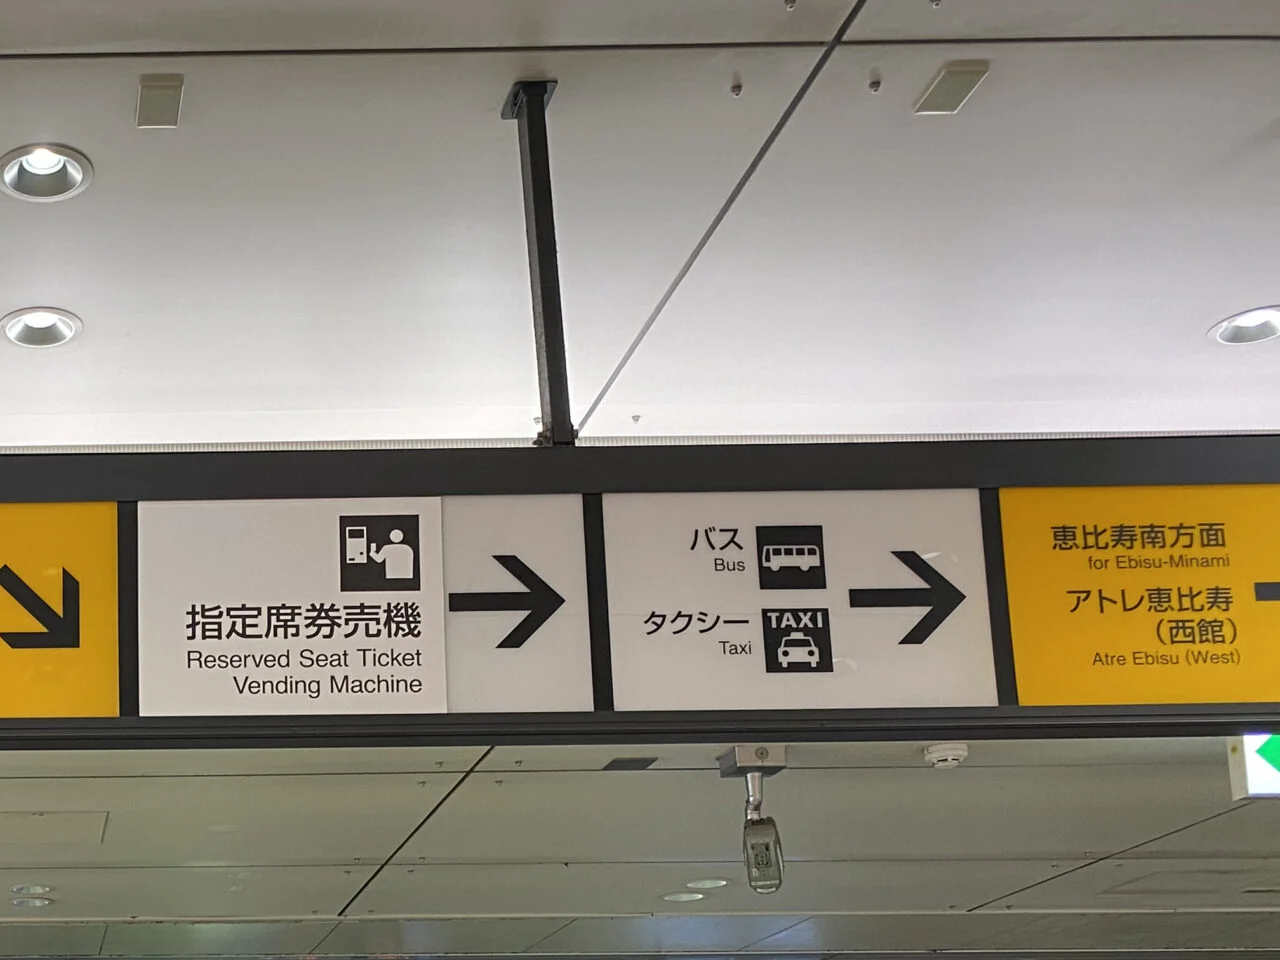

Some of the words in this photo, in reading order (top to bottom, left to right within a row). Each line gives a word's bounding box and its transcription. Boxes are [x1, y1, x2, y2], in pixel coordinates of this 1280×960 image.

[690, 527, 744, 551] バス
[1051, 523, 1226, 551] 恵比寿南方面
[714, 558, 745, 572] Bus
[1088, 556, 1109, 569] for
[1115, 553, 1230, 568] Ebisu-Minami
[1065, 587, 1233, 613] アトレ恵比寿
[186, 602, 422, 641] 指定席券売機
[643, 611, 750, 635] タクシー
[767, 612, 823, 628] TAXI
[187, 650, 291, 669] Reserved
[300, 649, 349, 668] Seat
[356, 648, 422, 668] Ticket
[719, 641, 752, 655] Taxi
[1092, 652, 1126, 666] Atre
[1133, 651, 1180, 666] Ebisu
[1185, 648, 1241, 667] (West)
[233, 677, 321, 699] Vending
[330, 675, 422, 695] Machine
